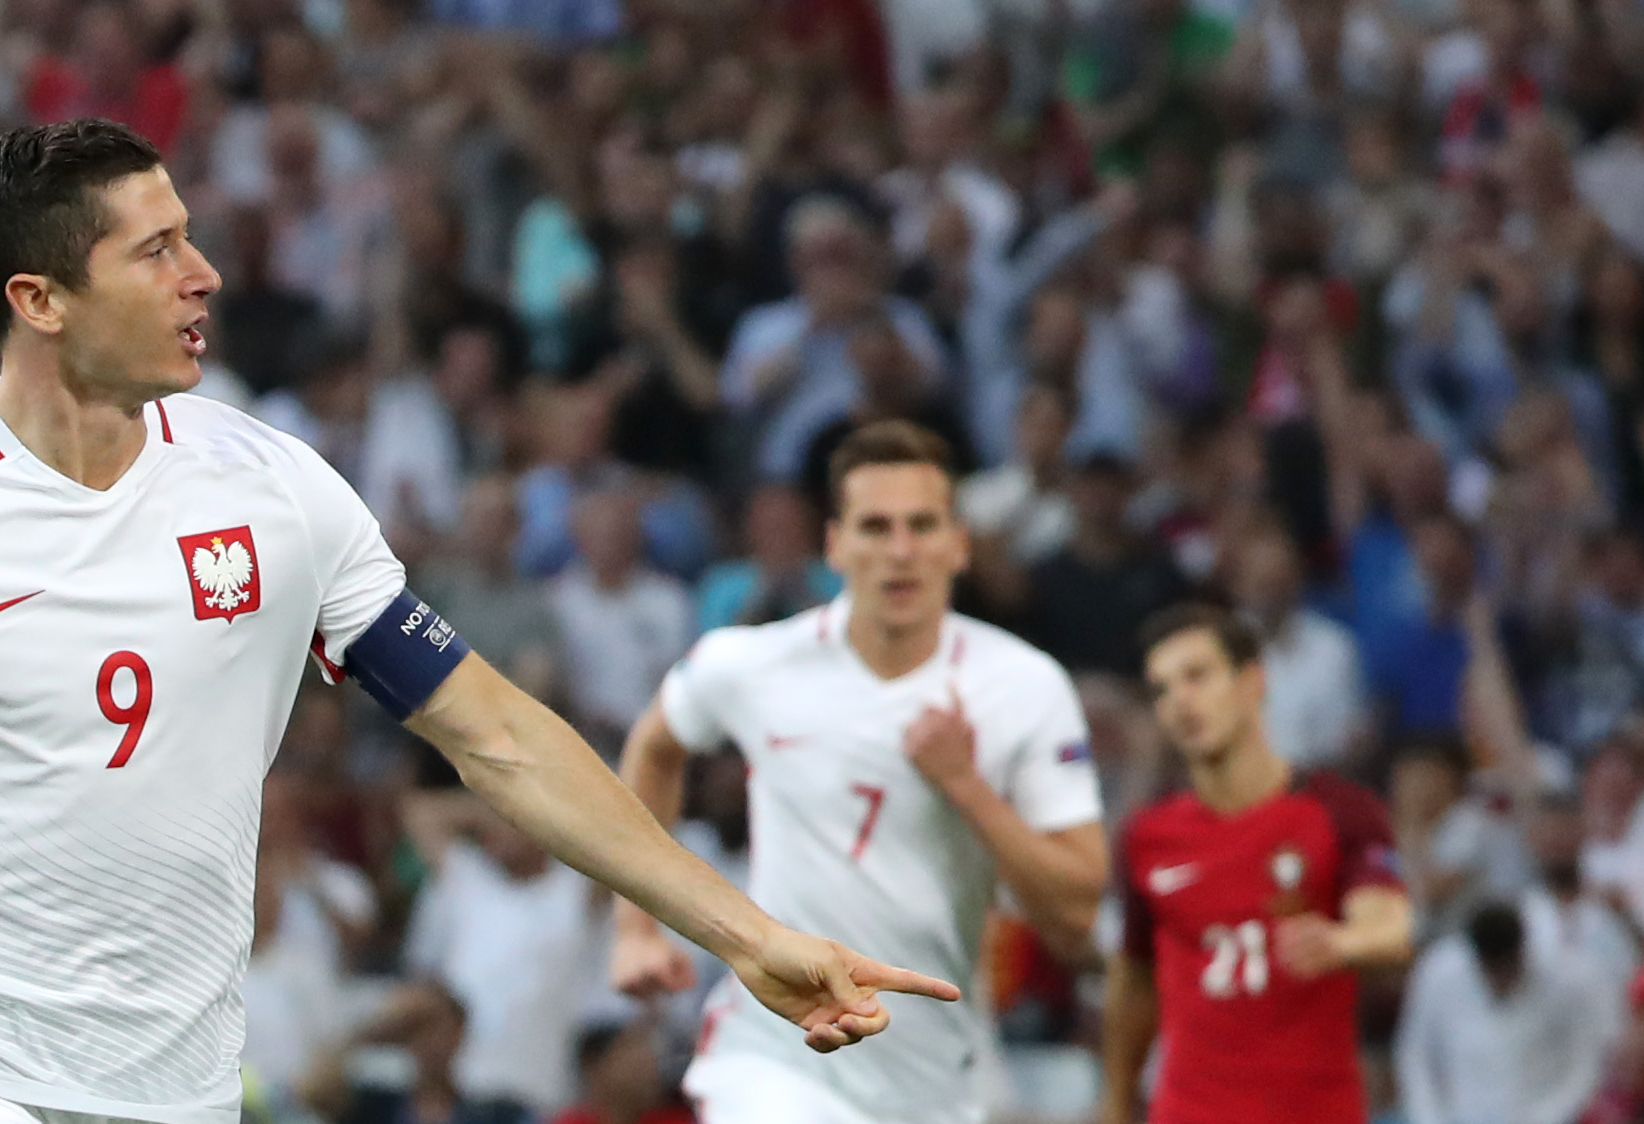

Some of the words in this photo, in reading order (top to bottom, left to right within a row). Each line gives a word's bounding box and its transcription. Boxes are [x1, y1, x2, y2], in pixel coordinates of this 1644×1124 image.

[400, 612, 423, 636] NO
[96, 650, 153, 769] 9
[849, 780, 885, 863] 7
[1199, 919, 1270, 999] 21
